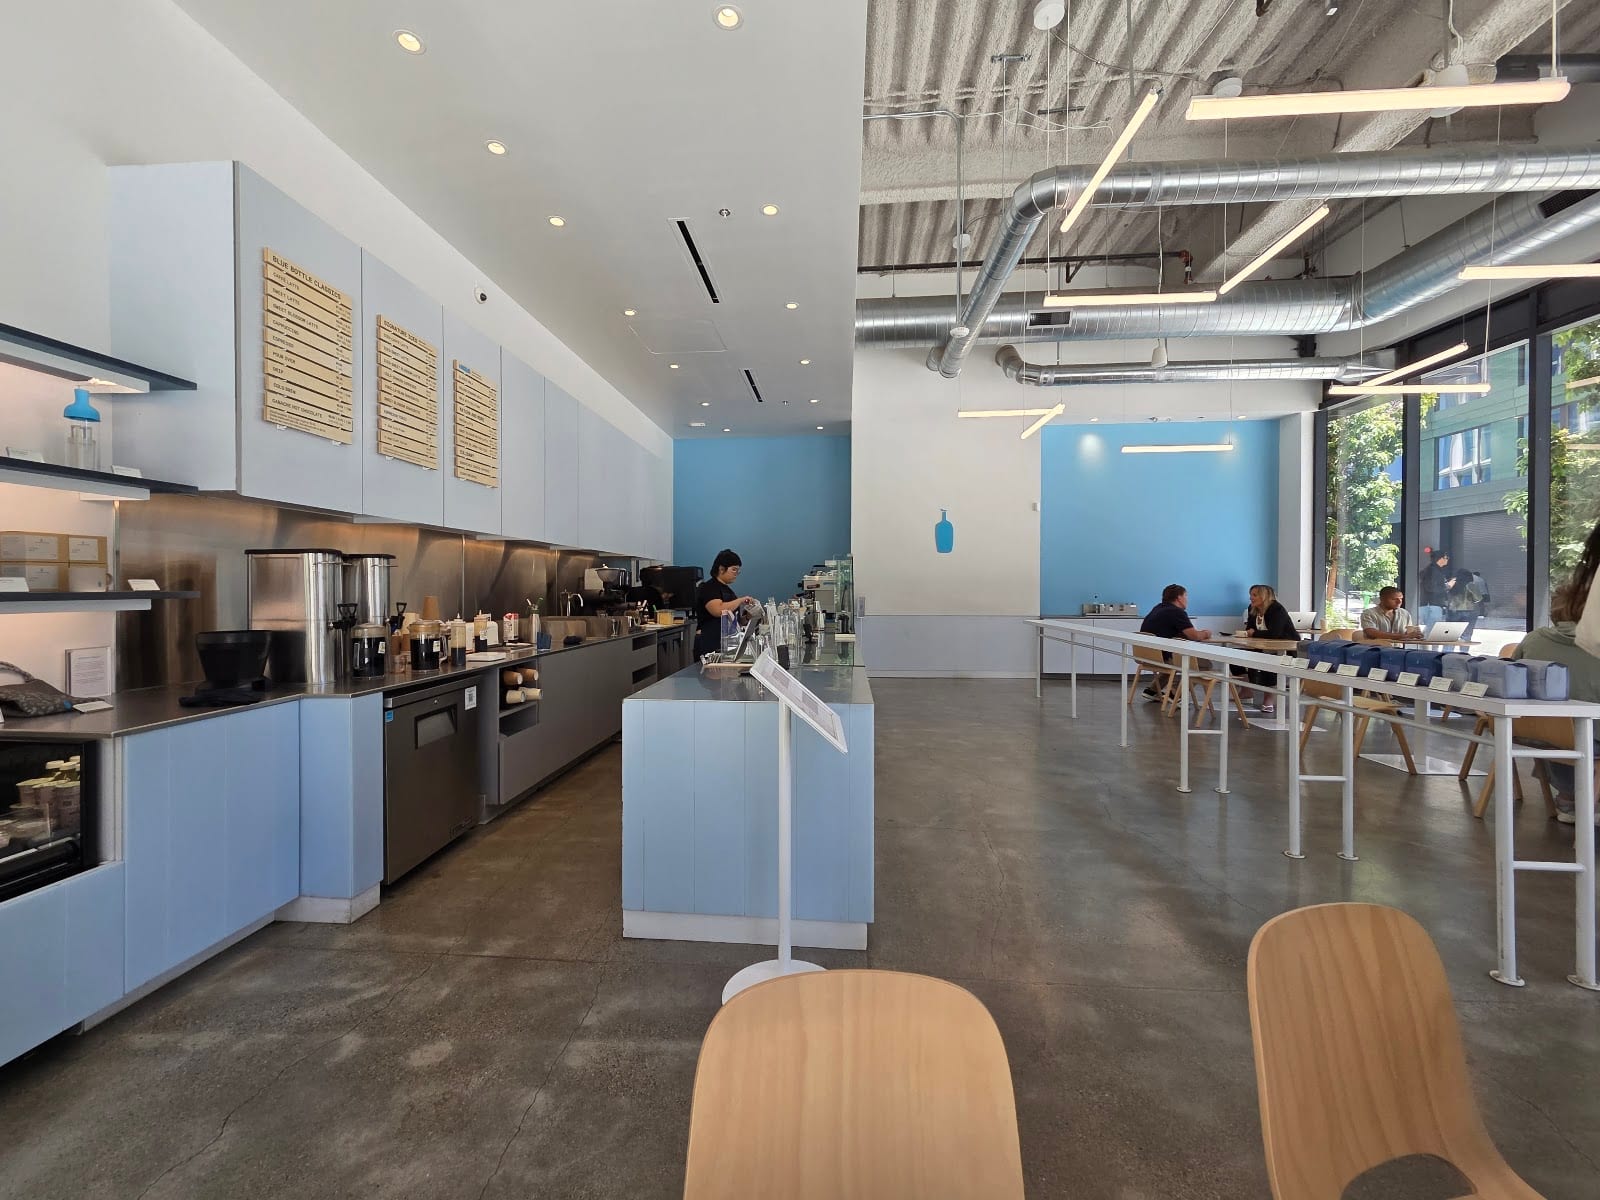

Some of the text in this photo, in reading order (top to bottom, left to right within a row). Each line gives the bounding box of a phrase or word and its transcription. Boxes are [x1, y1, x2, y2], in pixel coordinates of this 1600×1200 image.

[272, 255, 341, 300] BLUE BOTTLE CLASSICS
